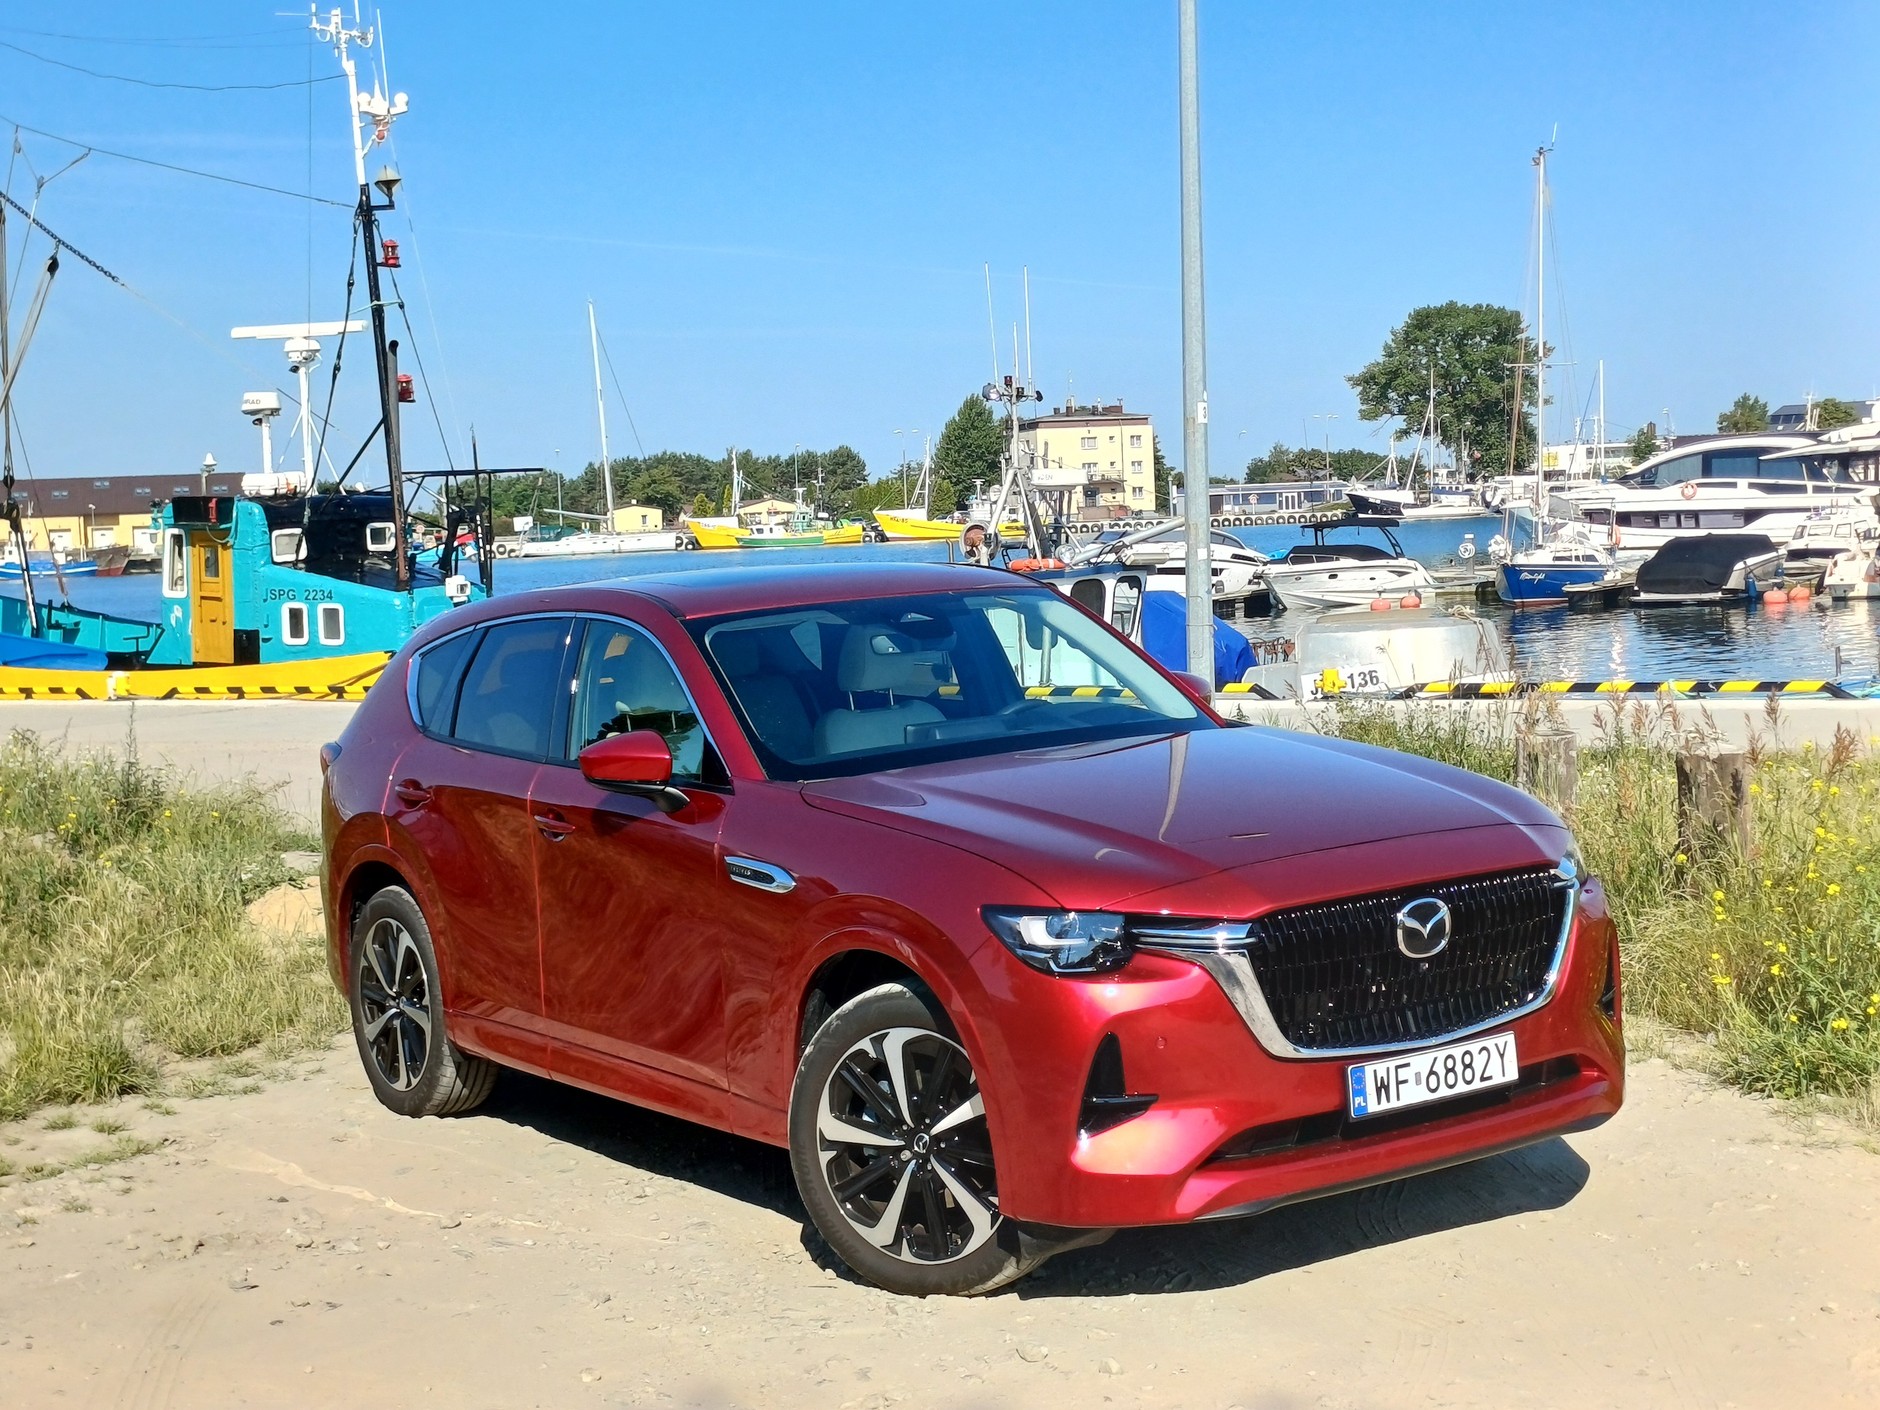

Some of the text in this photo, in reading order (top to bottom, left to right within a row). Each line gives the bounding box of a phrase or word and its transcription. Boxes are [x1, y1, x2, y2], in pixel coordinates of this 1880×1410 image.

[269, 588, 334, 601] SPG 2234
[1347, 669, 1380, 690] 136
[1373, 1040, 1509, 1106] WF 6882Y
[1354, 1097, 1367, 1108] PL
